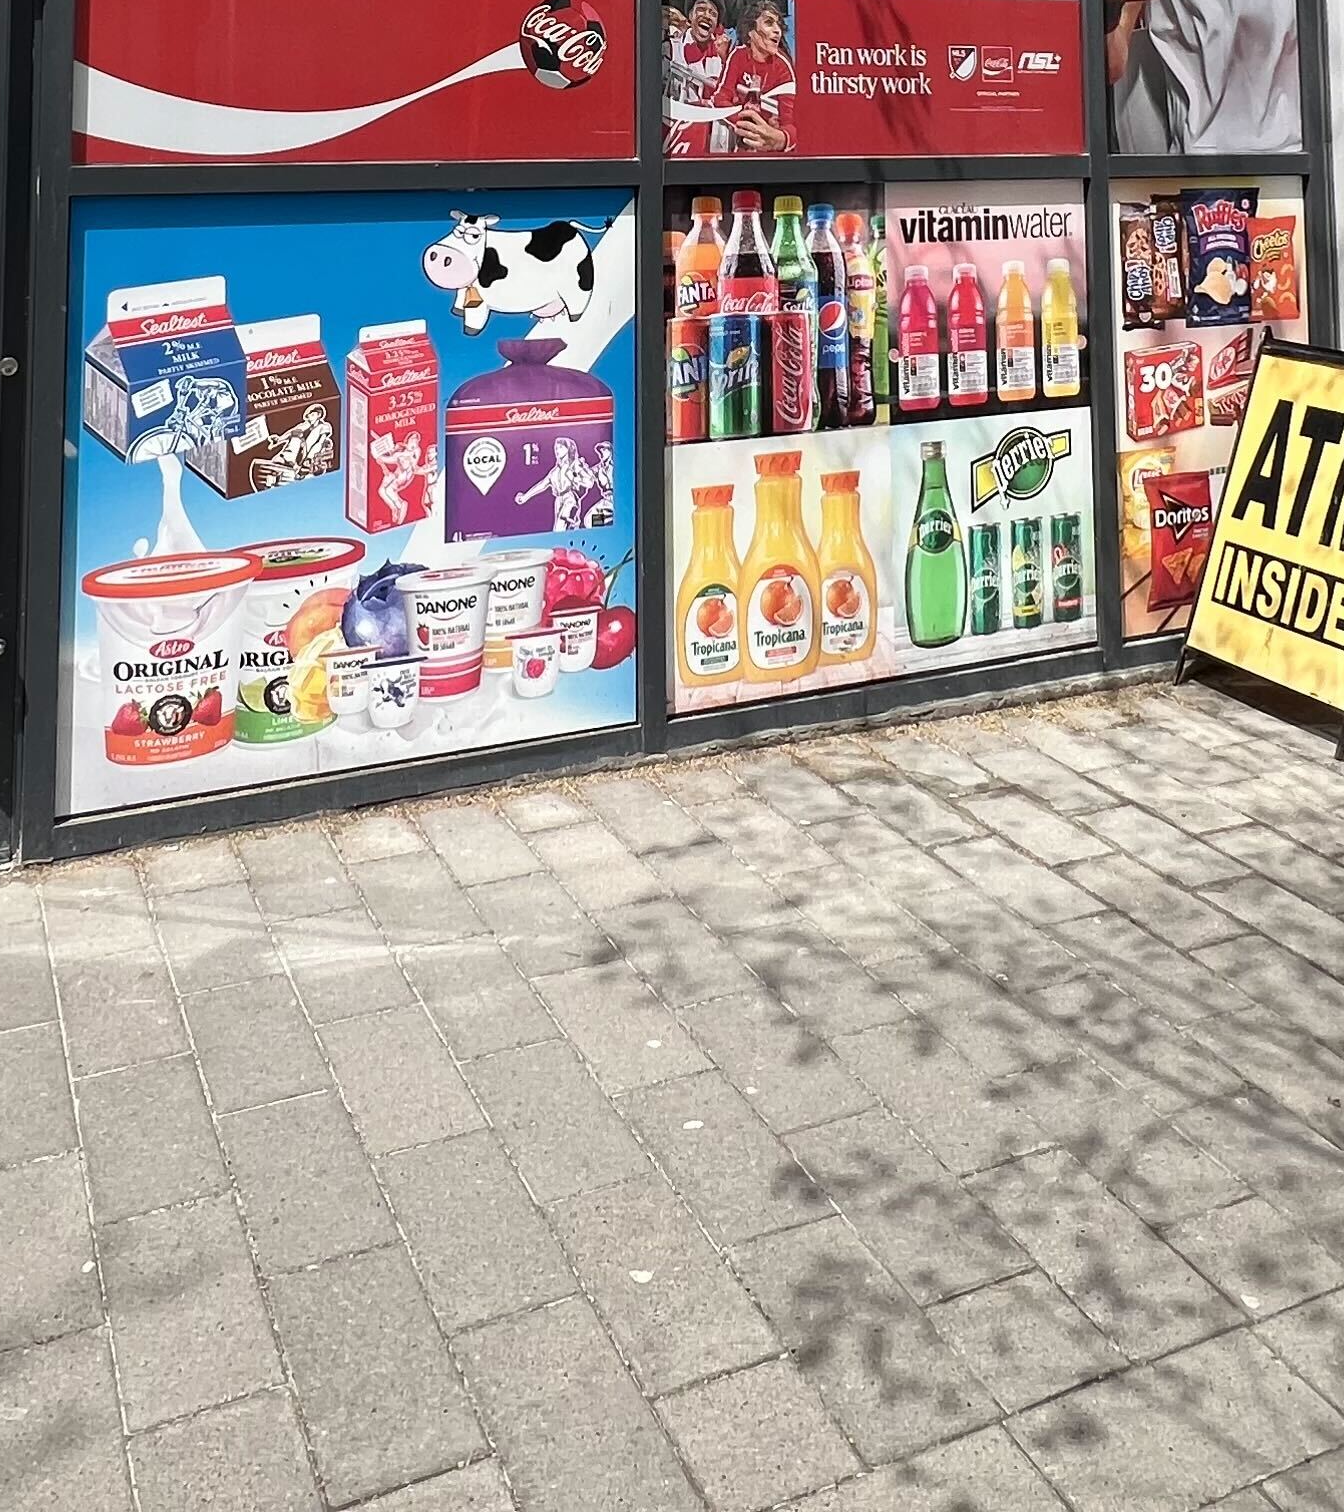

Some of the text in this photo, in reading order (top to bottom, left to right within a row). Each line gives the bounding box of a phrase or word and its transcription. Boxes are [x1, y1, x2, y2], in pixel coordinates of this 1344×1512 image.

[816, 42, 928, 66] Fan work is
[811, 70, 933, 100] thirsty work
[1192, 199, 1249, 236] Ruffles
[1252, 229, 1289, 261] Cheetos
[677, 281, 716, 307] FANTA
[141, 313, 208, 337] Sealtest
[162, 340, 186, 355] 2%
[172, 351, 200, 363] MILK
[247, 349, 301, 372] ealtest
[261, 375, 283, 390] 1%
[296, 379, 322, 393] MILK
[380, 367, 432, 389] Sealtest
[1139, 362, 1173, 392] 30
[375, 402, 436, 425] HOMOGENIZED
[394, 416, 417, 429] MILK
[466, 455, 502, 466] LOCAL
[1154, 506, 1210, 529] Doritos
[490, 575, 536, 592] ANONE
[754, 629, 806, 647] Tropicana
[823, 619, 864, 637] Tropicana
[156, 640, 191, 658] Astro
[691, 639, 737, 657] Tropicana
[113, 649, 230, 682] ORIGINAL
[115, 682, 185, 695] LACTOSE
[190, 670, 228, 688] FREE
[133, 731, 206, 748] STRAWBERRY
